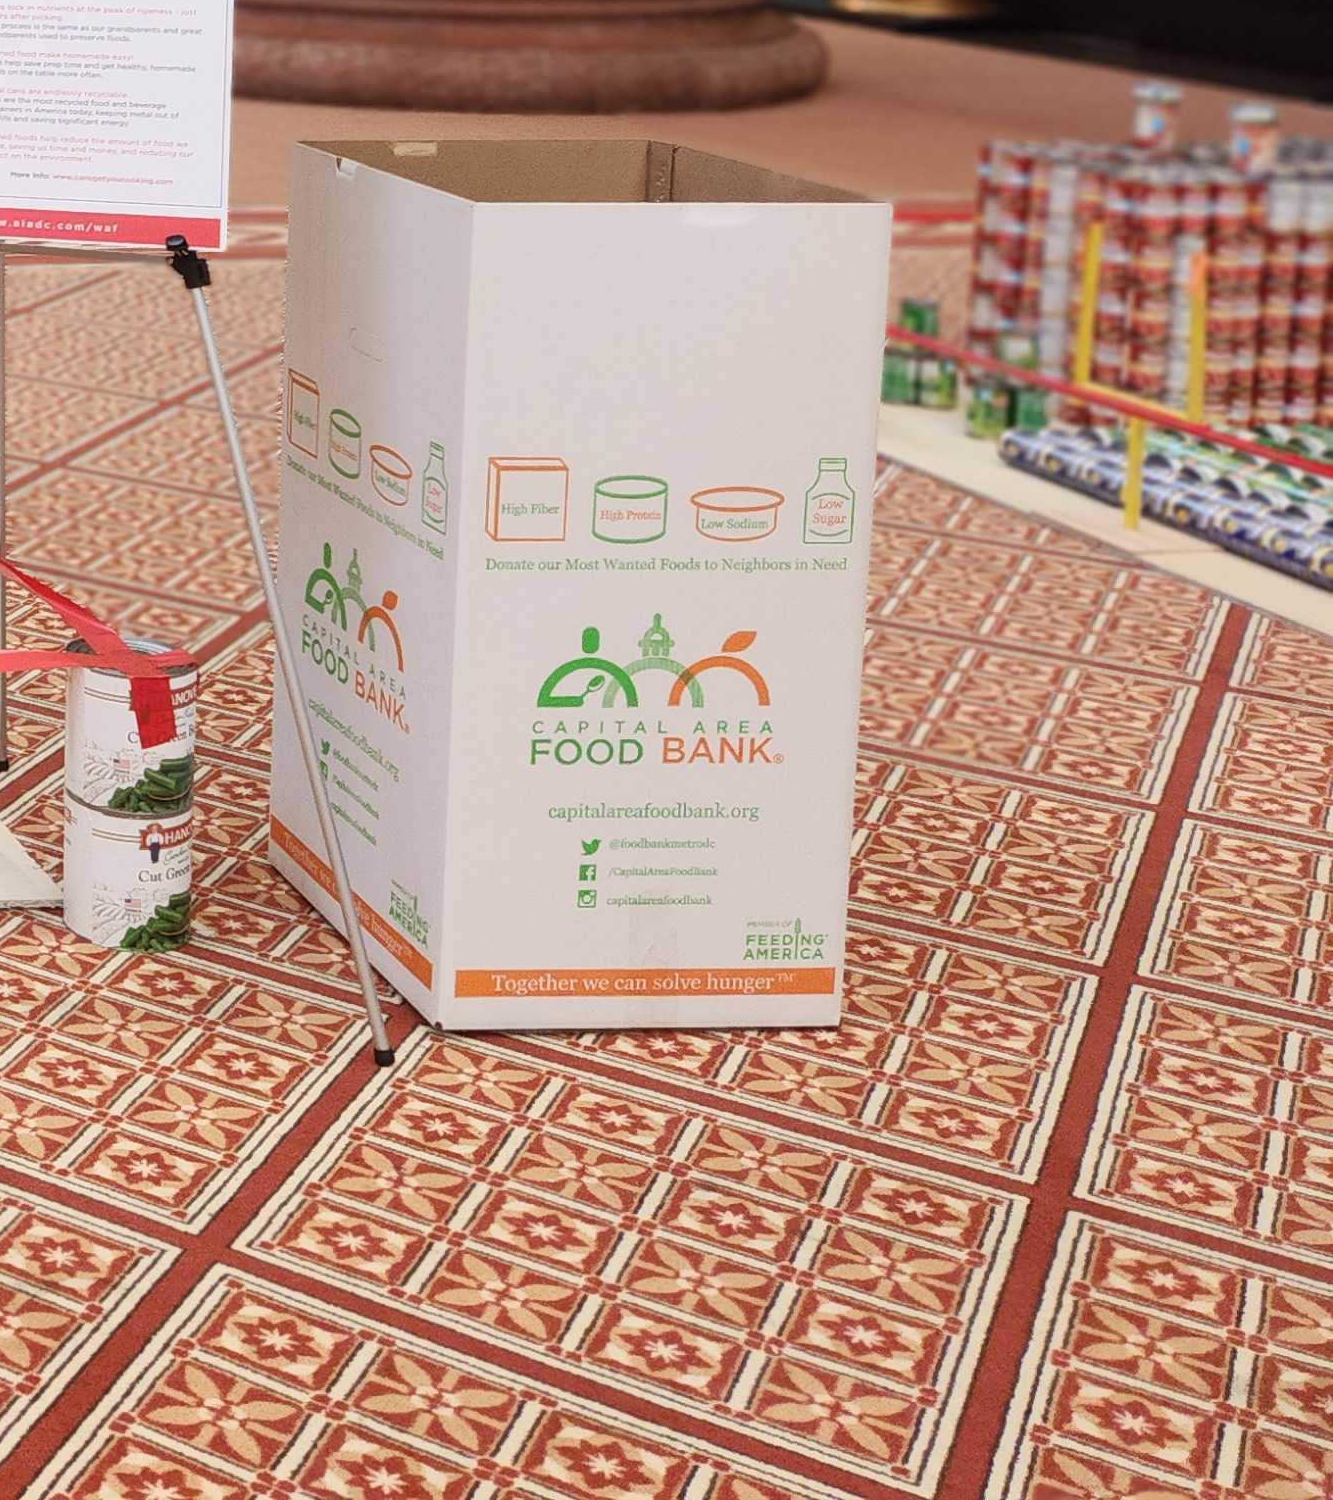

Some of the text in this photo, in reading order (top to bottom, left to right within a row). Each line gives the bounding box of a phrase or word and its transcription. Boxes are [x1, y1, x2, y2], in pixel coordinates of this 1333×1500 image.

[501, 503, 559, 516] High Fiber
[817, 499, 844, 510] Low
[600, 509, 662, 522] High Protein
[812, 512, 847, 526] Sugar
[701, 518, 769, 529] Low Sodium
[485, 557, 847, 574] Donate our Most Wanted Foods to Neighbors in Need
[301, 630, 349, 685] FOOD
[302, 614, 406, 699] CAPITAL AREA
[532, 720, 774, 734] CAPITAL AREA
[531, 738, 644, 766] FOOD
[548, 803, 760, 822] capitalareafoodbank.org
[138, 870, 162, 882] Cut
[606, 895, 713, 907] capitalareafoodbank
[743, 948, 824, 960] AMERICA
[491, 973, 577, 994] Together
[582, 978, 610, 991] we
[614, 977, 646, 991] can
[655, 973, 699, 991] solve
